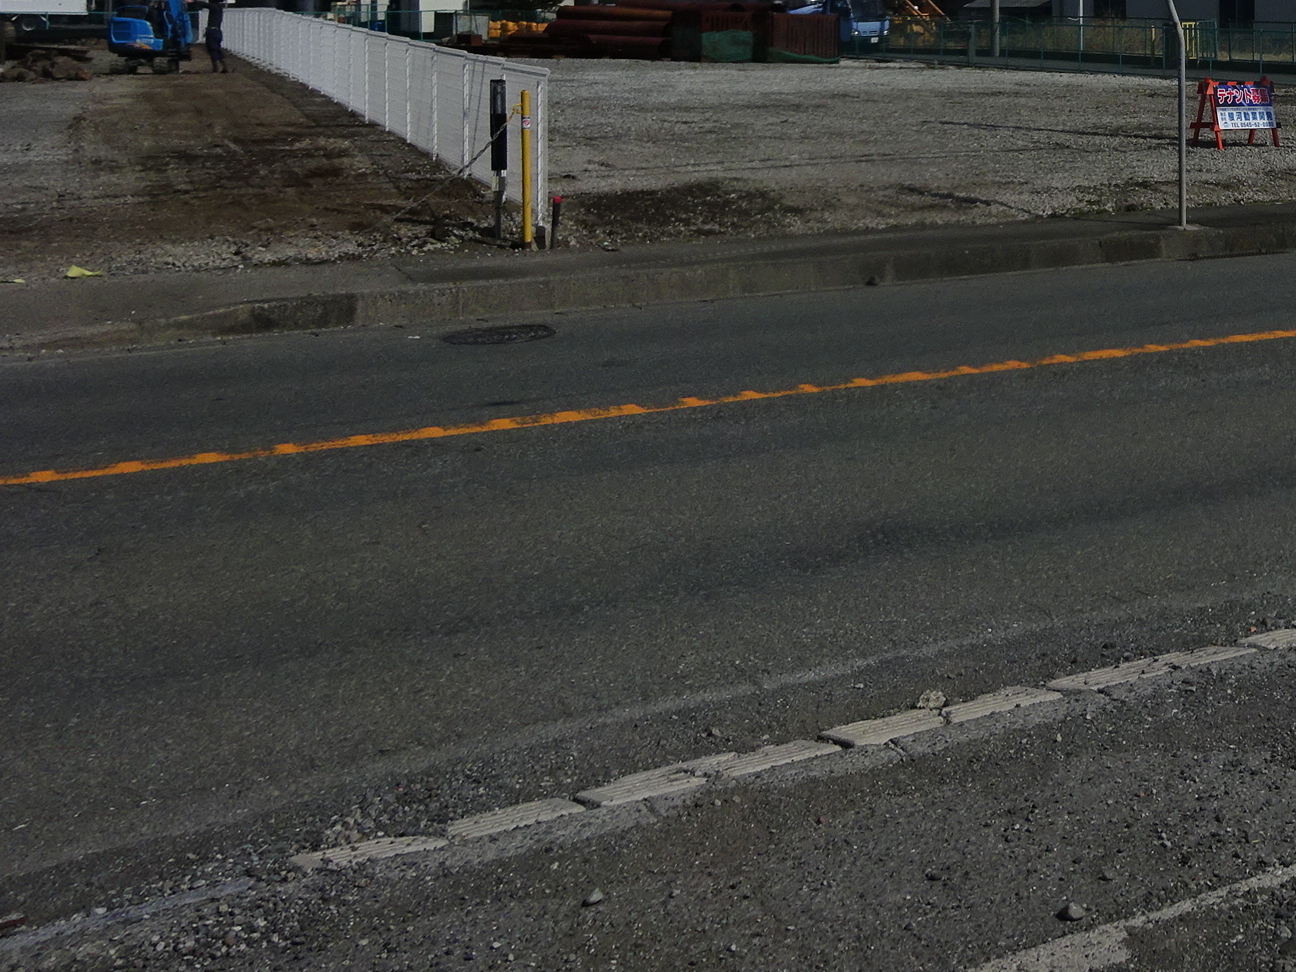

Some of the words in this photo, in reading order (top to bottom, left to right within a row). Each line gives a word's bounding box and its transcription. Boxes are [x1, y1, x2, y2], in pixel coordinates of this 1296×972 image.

[1217, 88, 1270, 104] テナント募集
